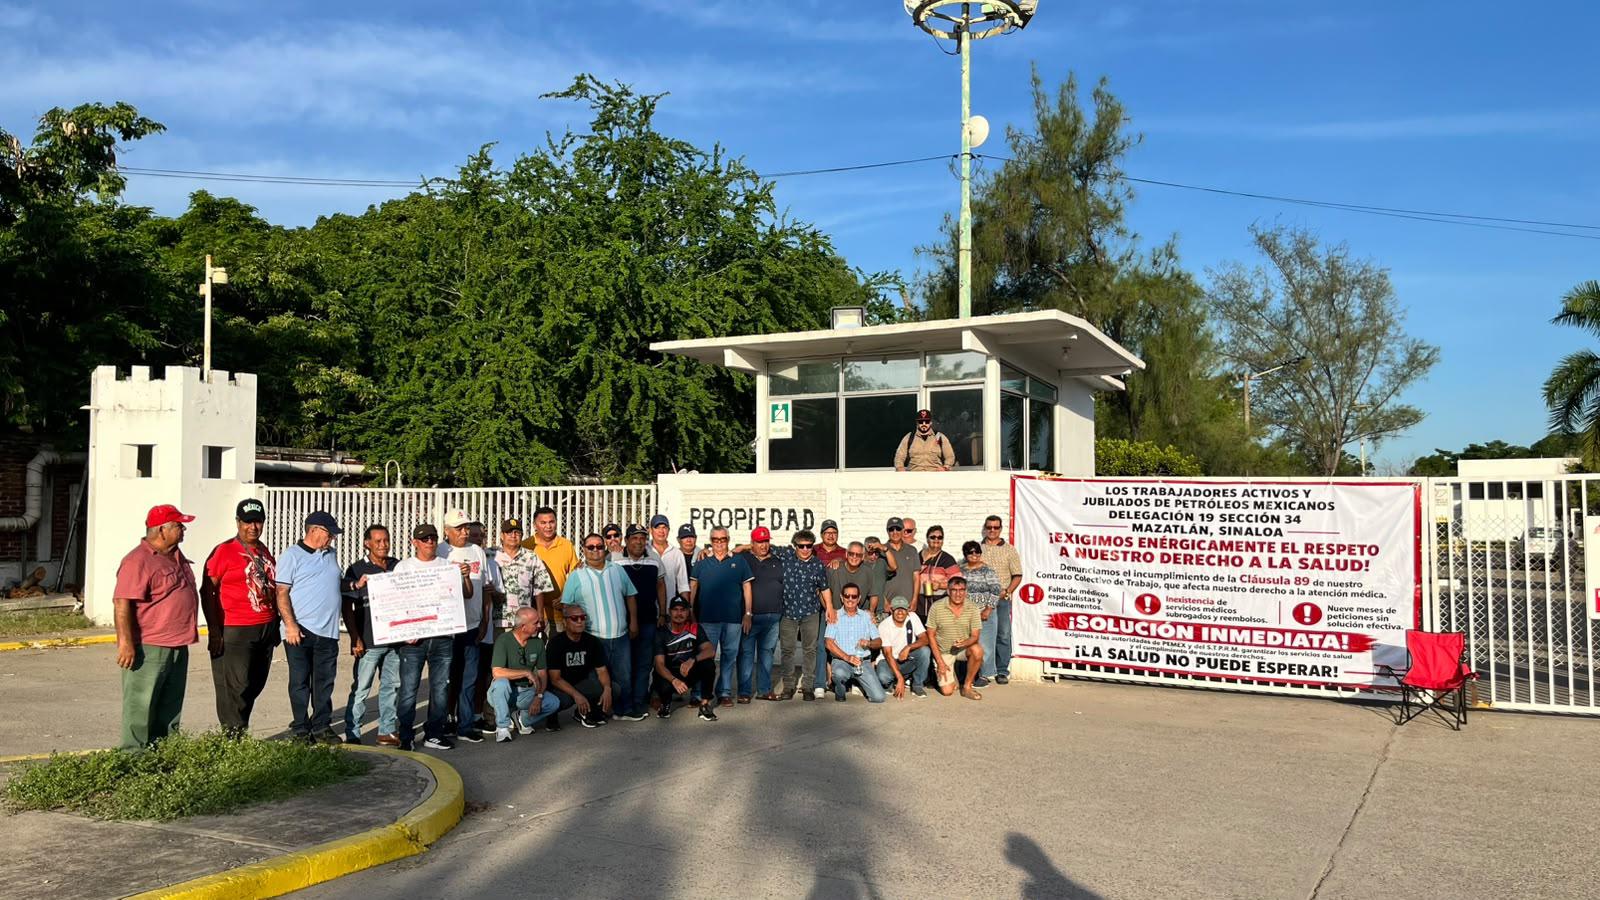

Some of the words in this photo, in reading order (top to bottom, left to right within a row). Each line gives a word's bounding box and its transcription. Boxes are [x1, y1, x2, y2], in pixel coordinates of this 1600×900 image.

[1105, 486, 1128, 496] LOS
[1132, 486, 1237, 498] TRABAJADORES
[1241, 488, 1299, 498] ACTIVOS
[1301, 489, 1311, 498] Y
[1082, 496, 1151, 507] JUBILADOS
[1154, 498, 1170, 508] DE
[1174, 497, 1249, 509] PETRÓLEOS
[1253, 501, 1335, 511] MEXICANOS
[690, 508, 814, 530] PROPIEDAD
[1108, 510, 1194, 522] DELEGACIÓN
[1198, 513, 1214, 522] 19
[1218, 512, 1281, 524] SECCIÓN
[1284, 514, 1301, 524] 34
[1132, 523, 1213, 536] MAZATLÁN,
[1218, 526, 1283, 537] SINALOA
[1049, 532, 1133, 547] ¡EXIGIMOS
[1138, 536, 1276, 554] ENÉRGICAMENTE
[1280, 542, 1299, 554] EL
[1304, 543, 1380, 556] RESPETO
[1059, 547, 1069, 557] A
[1075, 548, 1154, 563] NUESTRO
[1159, 552, 1243, 567] DERECHO
[1249, 556, 1262, 568] A
[1268, 557, 1291, 569] LA
[1298, 557, 1370, 572] SALUD!
[1060, 563, 1120, 577] Denunciamos
[1134, 570, 1210, 582] incumplimiento
[1212, 574, 1225, 582] de
[1227, 575, 1237, 583] la
[1239, 574, 1291, 585] Cláusula
[1294, 576, 1310, 586] 89
[1313, 579, 1325, 587] de
[1036, 571, 1072, 580] Contrato
[1074, 574, 1111, 585] Colectivo
[1127, 579, 1161, 589] Trabajo,
[1163, 582, 1180, 590] que
[1182, 582, 1210, 591] afecta
[1212, 585, 1247, 593] nuestro
[1249, 586, 1286, 595] derecho
[1297, 588, 1305, 596] la
[1308, 589, 1348, 597] atención
[1350, 590, 1387, 599] médica.
[1048, 586, 1066, 594] Falta
[1080, 588, 1109, 598] médicos
[1048, 593, 1095, 603] especialistas
[1166, 596, 1215, 605] Inexistencia
[1048, 601, 1103, 610] medicamentos.
[1203, 606, 1237, 614] médicos
[1166, 611, 1211, 621] subrogados
[1220, 615, 1268, 623] reembolsos.
[1327, 613, 1374, 622] peticiones
[1376, 614, 1389, 622] sin
[1327, 620, 1364, 628] solución
[1366, 622, 1404, 630] efectiva.
[1068, 616, 1194, 641] ¡SOLUCIÓN
[1201, 627, 1349, 650] INMEDIATA!
[1065, 632, 1094, 640] Exigimos
[1111, 636, 1150, 645] autoridades
[1241, 648, 1277, 656] garantizar
[1143, 645, 1187, 654] cumplimiento
[566, 651, 587, 667] CAT
[1075, 645, 1102, 658] ¡LA
[1108, 648, 1160, 664] SALUD
[1166, 654, 1190, 667] NO
[1196, 657, 1250, 672] PUEDE
[1257, 661, 1338, 678] ESPERAR!
